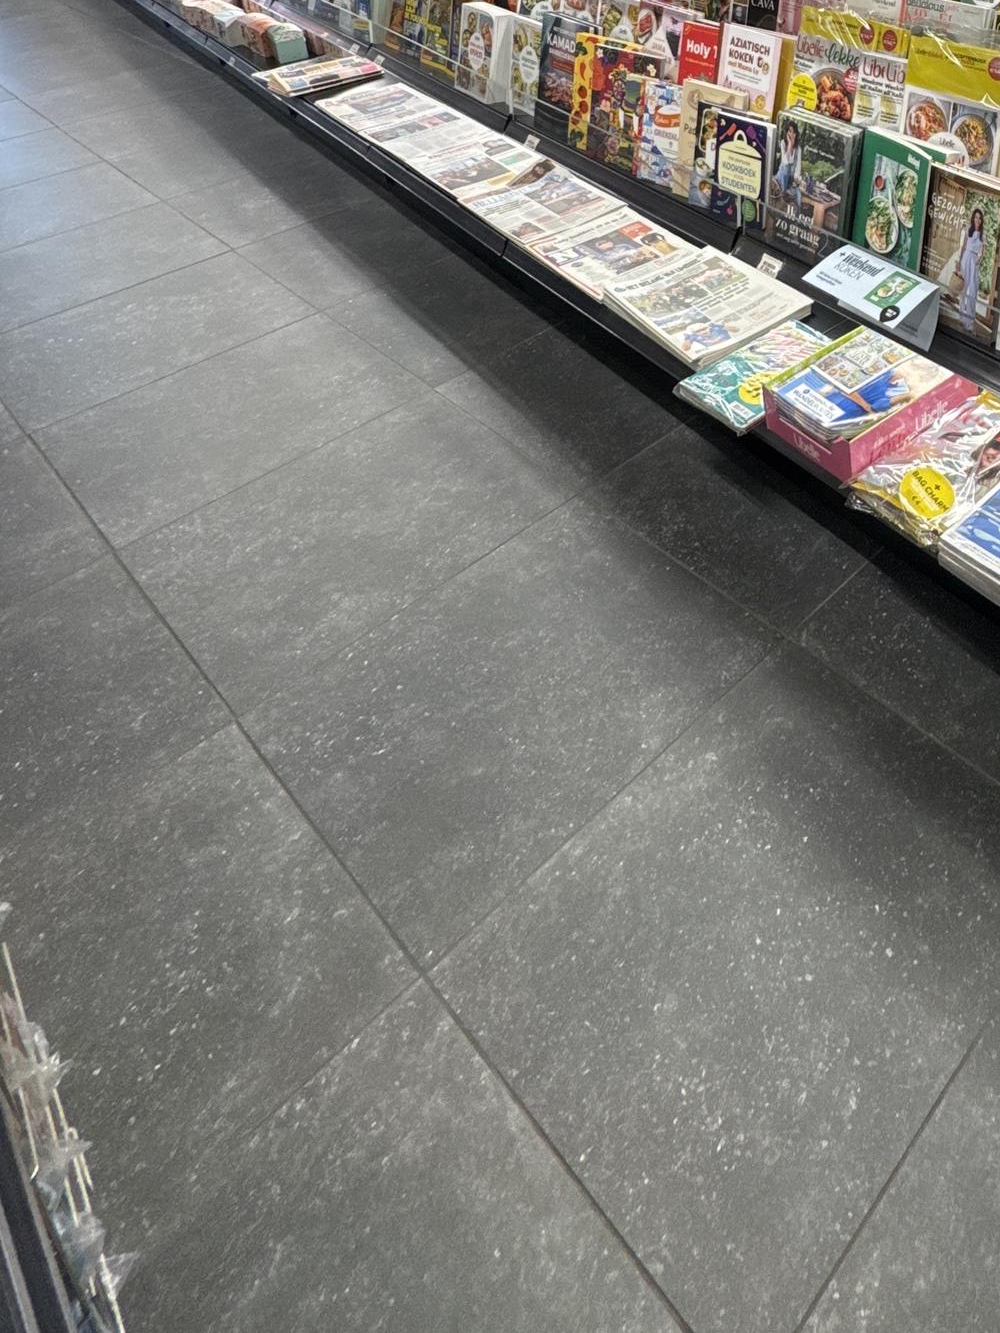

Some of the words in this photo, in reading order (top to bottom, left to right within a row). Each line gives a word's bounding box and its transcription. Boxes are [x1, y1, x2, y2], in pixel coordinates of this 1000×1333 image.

[686, 40, 710, 59] Holy
[730, 37, 771, 56] AZIATISCH
[729, 49, 754, 64] KOKEN
[721, 177, 757, 194] STUDENTEN
[912, 470, 926, 489] BAG
[924, 486, 948, 512] CHARM
